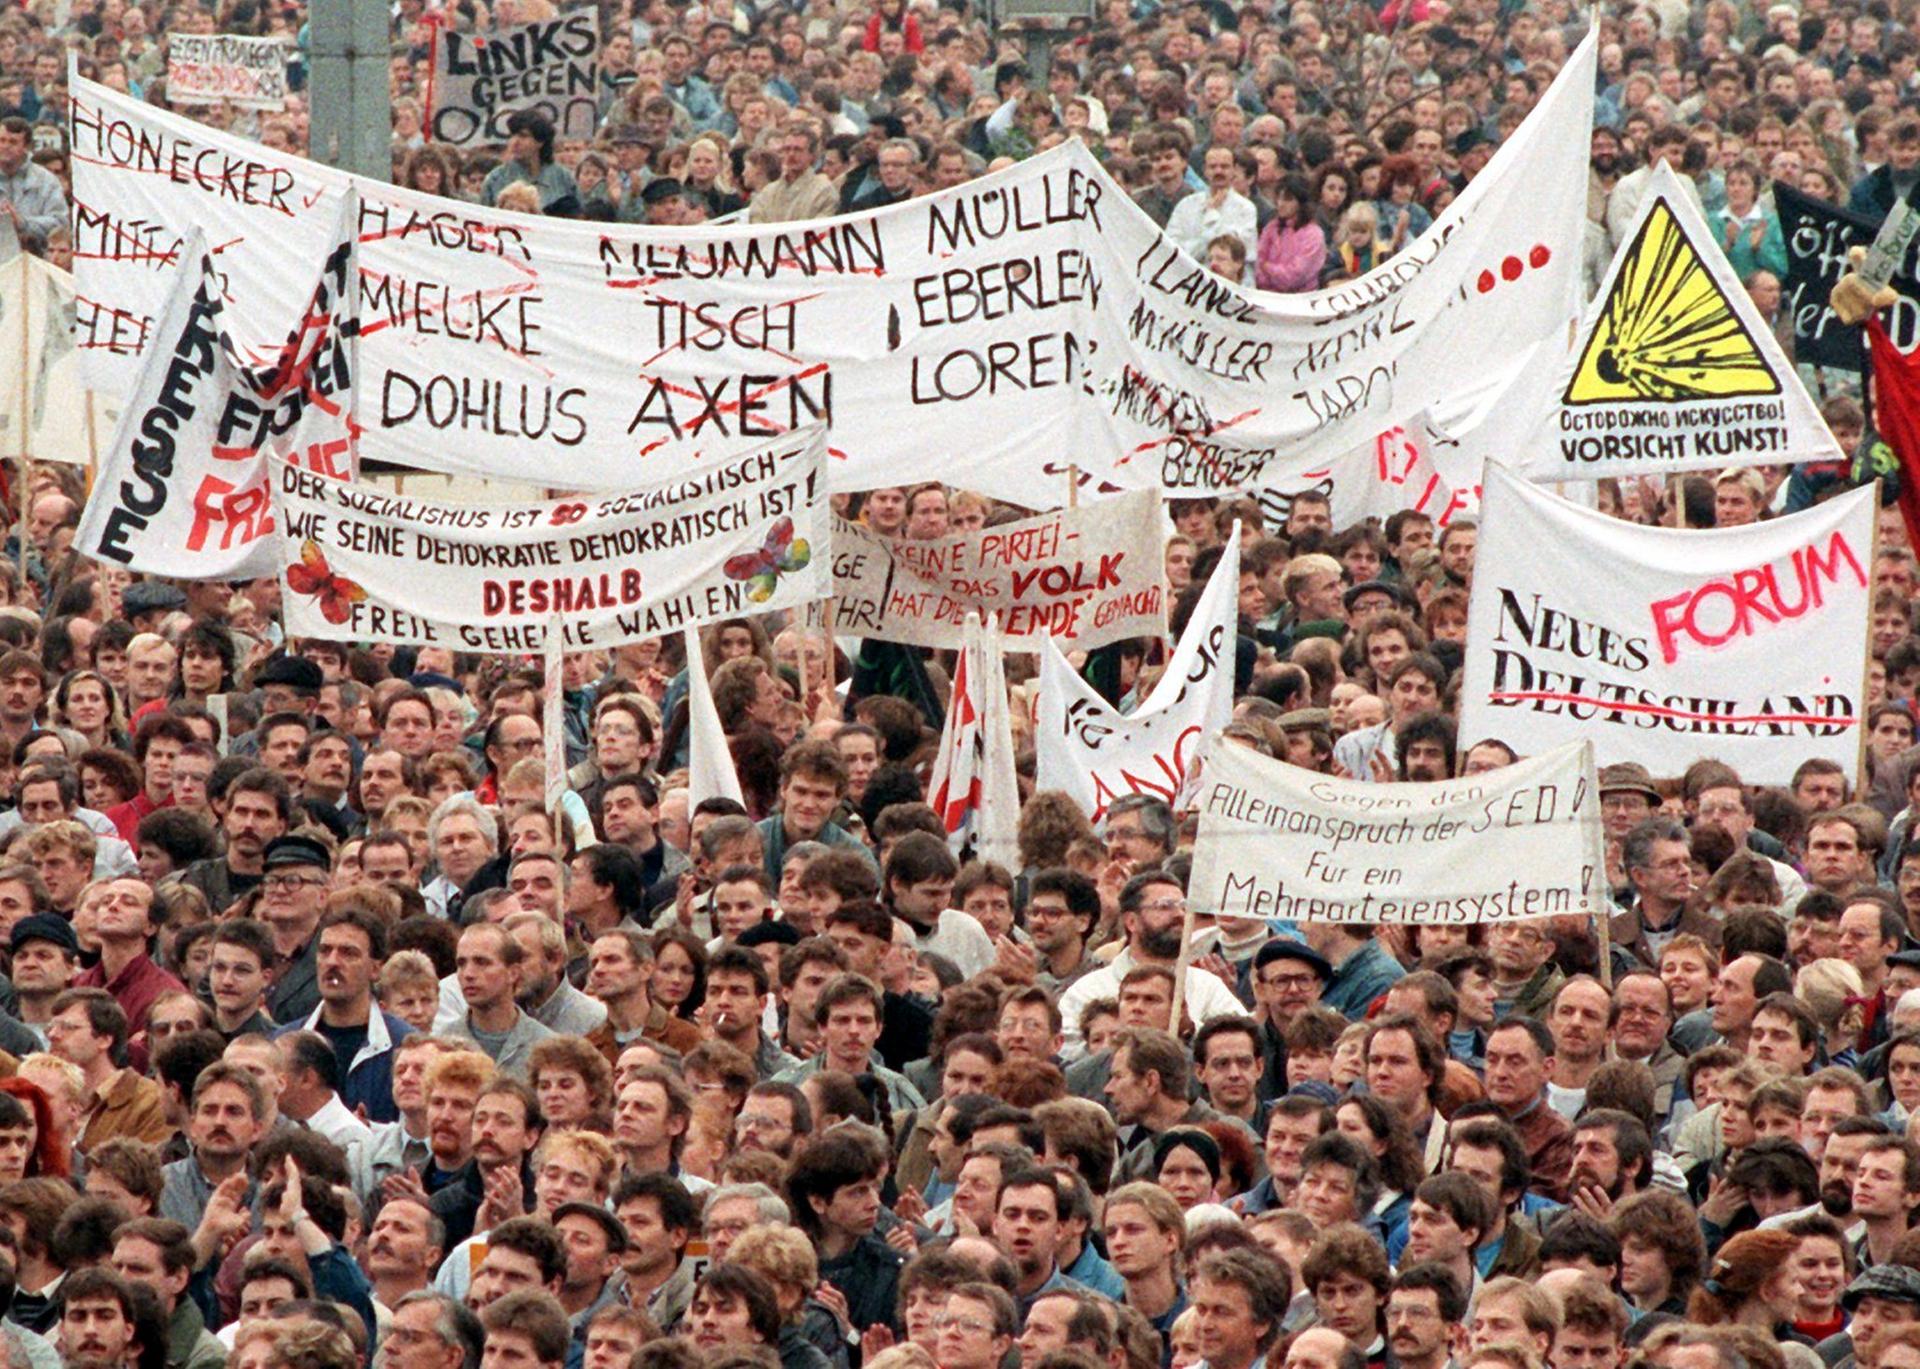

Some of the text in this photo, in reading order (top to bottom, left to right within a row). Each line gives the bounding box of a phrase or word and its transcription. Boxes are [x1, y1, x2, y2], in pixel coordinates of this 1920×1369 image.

[472, 62, 597, 108] GEGEN
[72, 97, 297, 213] HONECKER
[928, 168, 1102, 255] MÜLLER
[359, 273, 544, 356] MIELKE
[643, 301, 796, 351] TISCH
[381, 368, 588, 446] DOHLUS
[627, 372, 833, 440] AXEN
[1560, 427, 1788, 462] VORSICHT KUNST!
[282, 464, 326, 502] DER
[336, 487, 491, 529] SOZIALISMUS
[500, 509, 542, 529] IST
[548, 501, 588, 527] SO
[284, 465, 818, 568] WIE SEINE DEMOKRATIE DEMOKRATISCH IST!
[892, 542, 966, 573] KEINE
[950, 579, 1000, 598] DAS
[1011, 551, 1125, 600] VOLK
[351, 603, 438, 642] FREIE
[482, 568, 643, 617] DESHALB
[887, 589, 934, 619] HAT
[933, 595, 965, 626] DIE
[1093, 585, 1162, 629] GEMACHT
[1494, 531, 1868, 672] NEUES FORUM
[1488, 648, 1854, 739] DEUTSCHLAND
[1207, 783, 1415, 851] Alleinanspruch
[1422, 813, 1468, 842] der
[1309, 782, 1484, 812] Gegen den
[1220, 864, 1594, 924] Mehrparteiensystem!
[1363, 867, 1402, 885] ein
